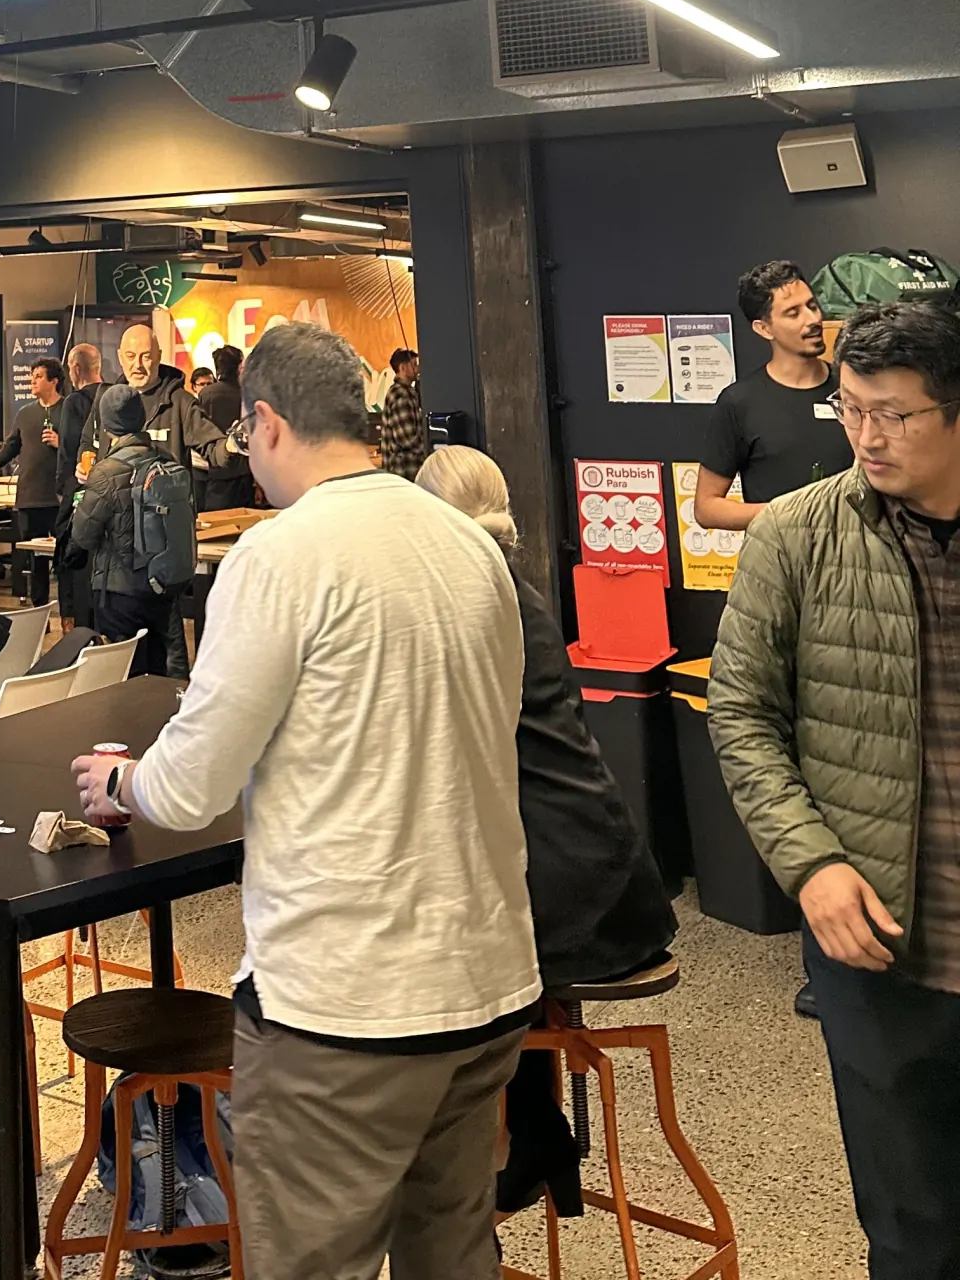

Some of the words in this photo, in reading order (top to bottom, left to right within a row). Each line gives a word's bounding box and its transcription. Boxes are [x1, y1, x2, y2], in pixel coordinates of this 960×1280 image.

[898, 281, 920, 290] FIRST
[922, 281, 936, 289] AID
[936, 280, 950, 289] KIT
[24, 337, 54, 346] STARTUP
[606, 467, 655, 479] Rubbish
[606, 479, 628, 488] Para
